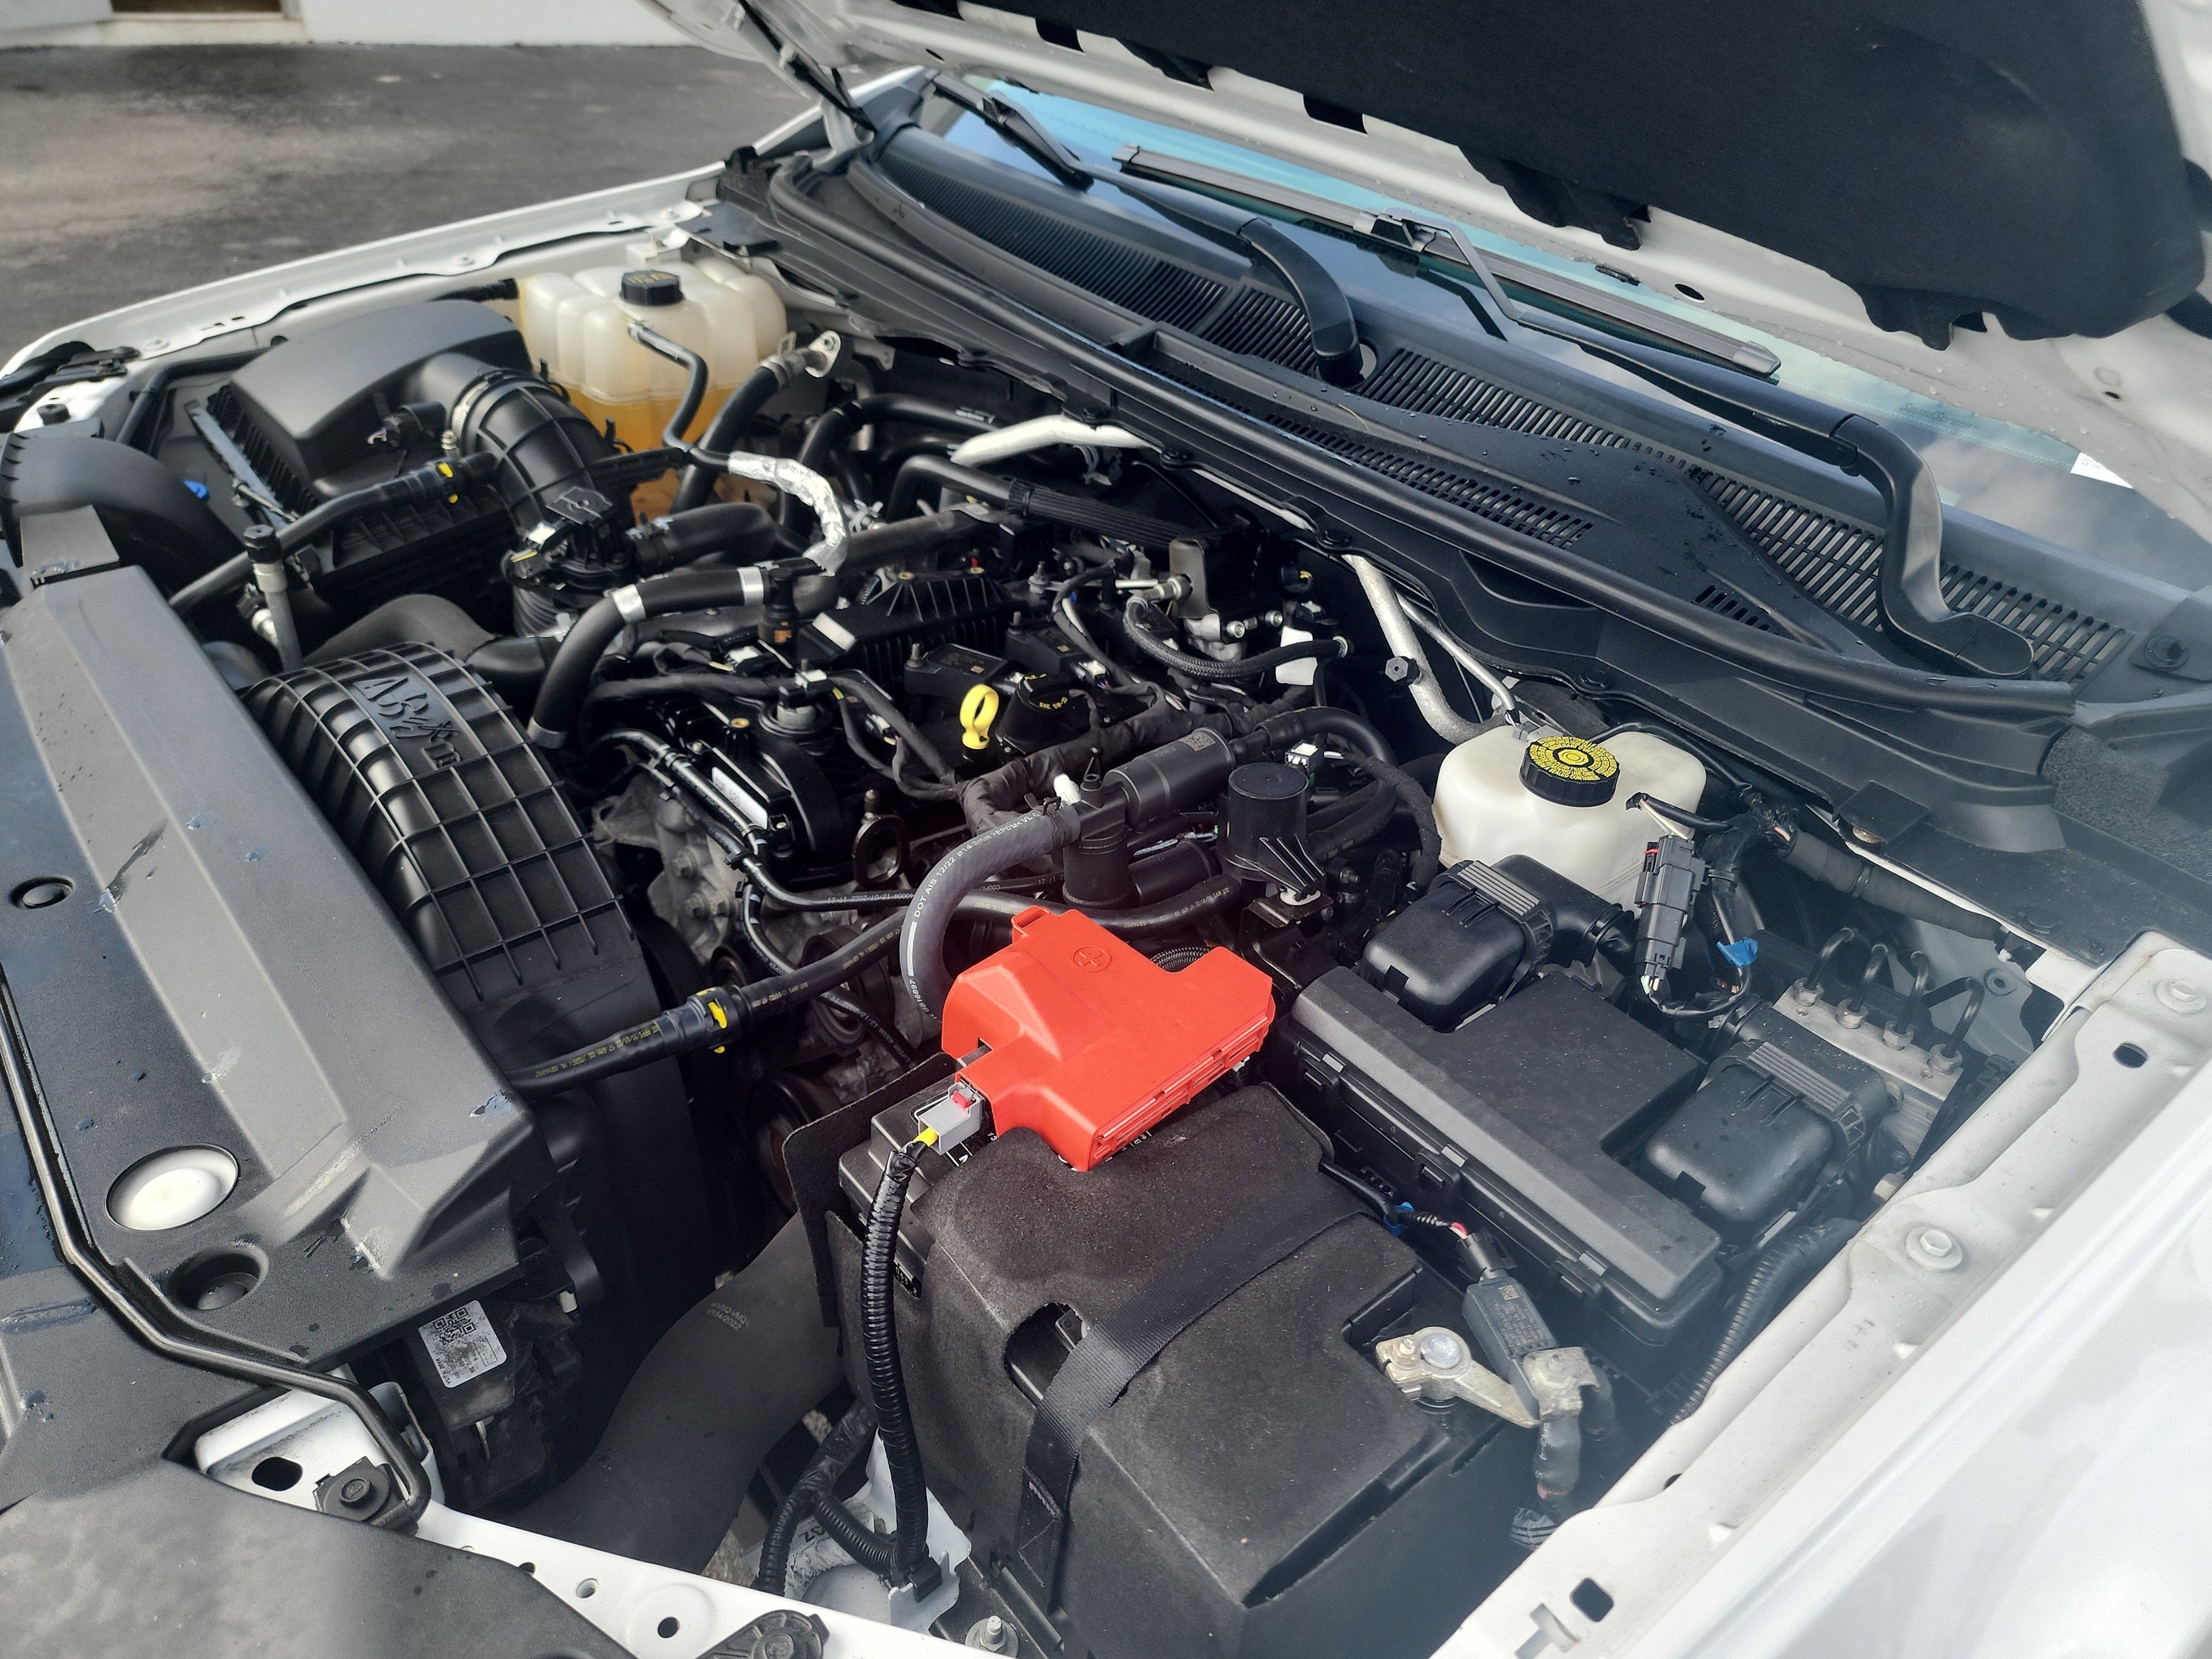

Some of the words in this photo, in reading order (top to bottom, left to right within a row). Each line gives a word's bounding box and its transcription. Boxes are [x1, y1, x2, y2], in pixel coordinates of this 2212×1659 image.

[914, 895, 926, 918] DOT
[925, 878, 937, 895] AIS
[936, 857, 957, 877] 12/22
[1021, 815, 1033, 825] VL
[909, 979, 930, 1014] GB16897
